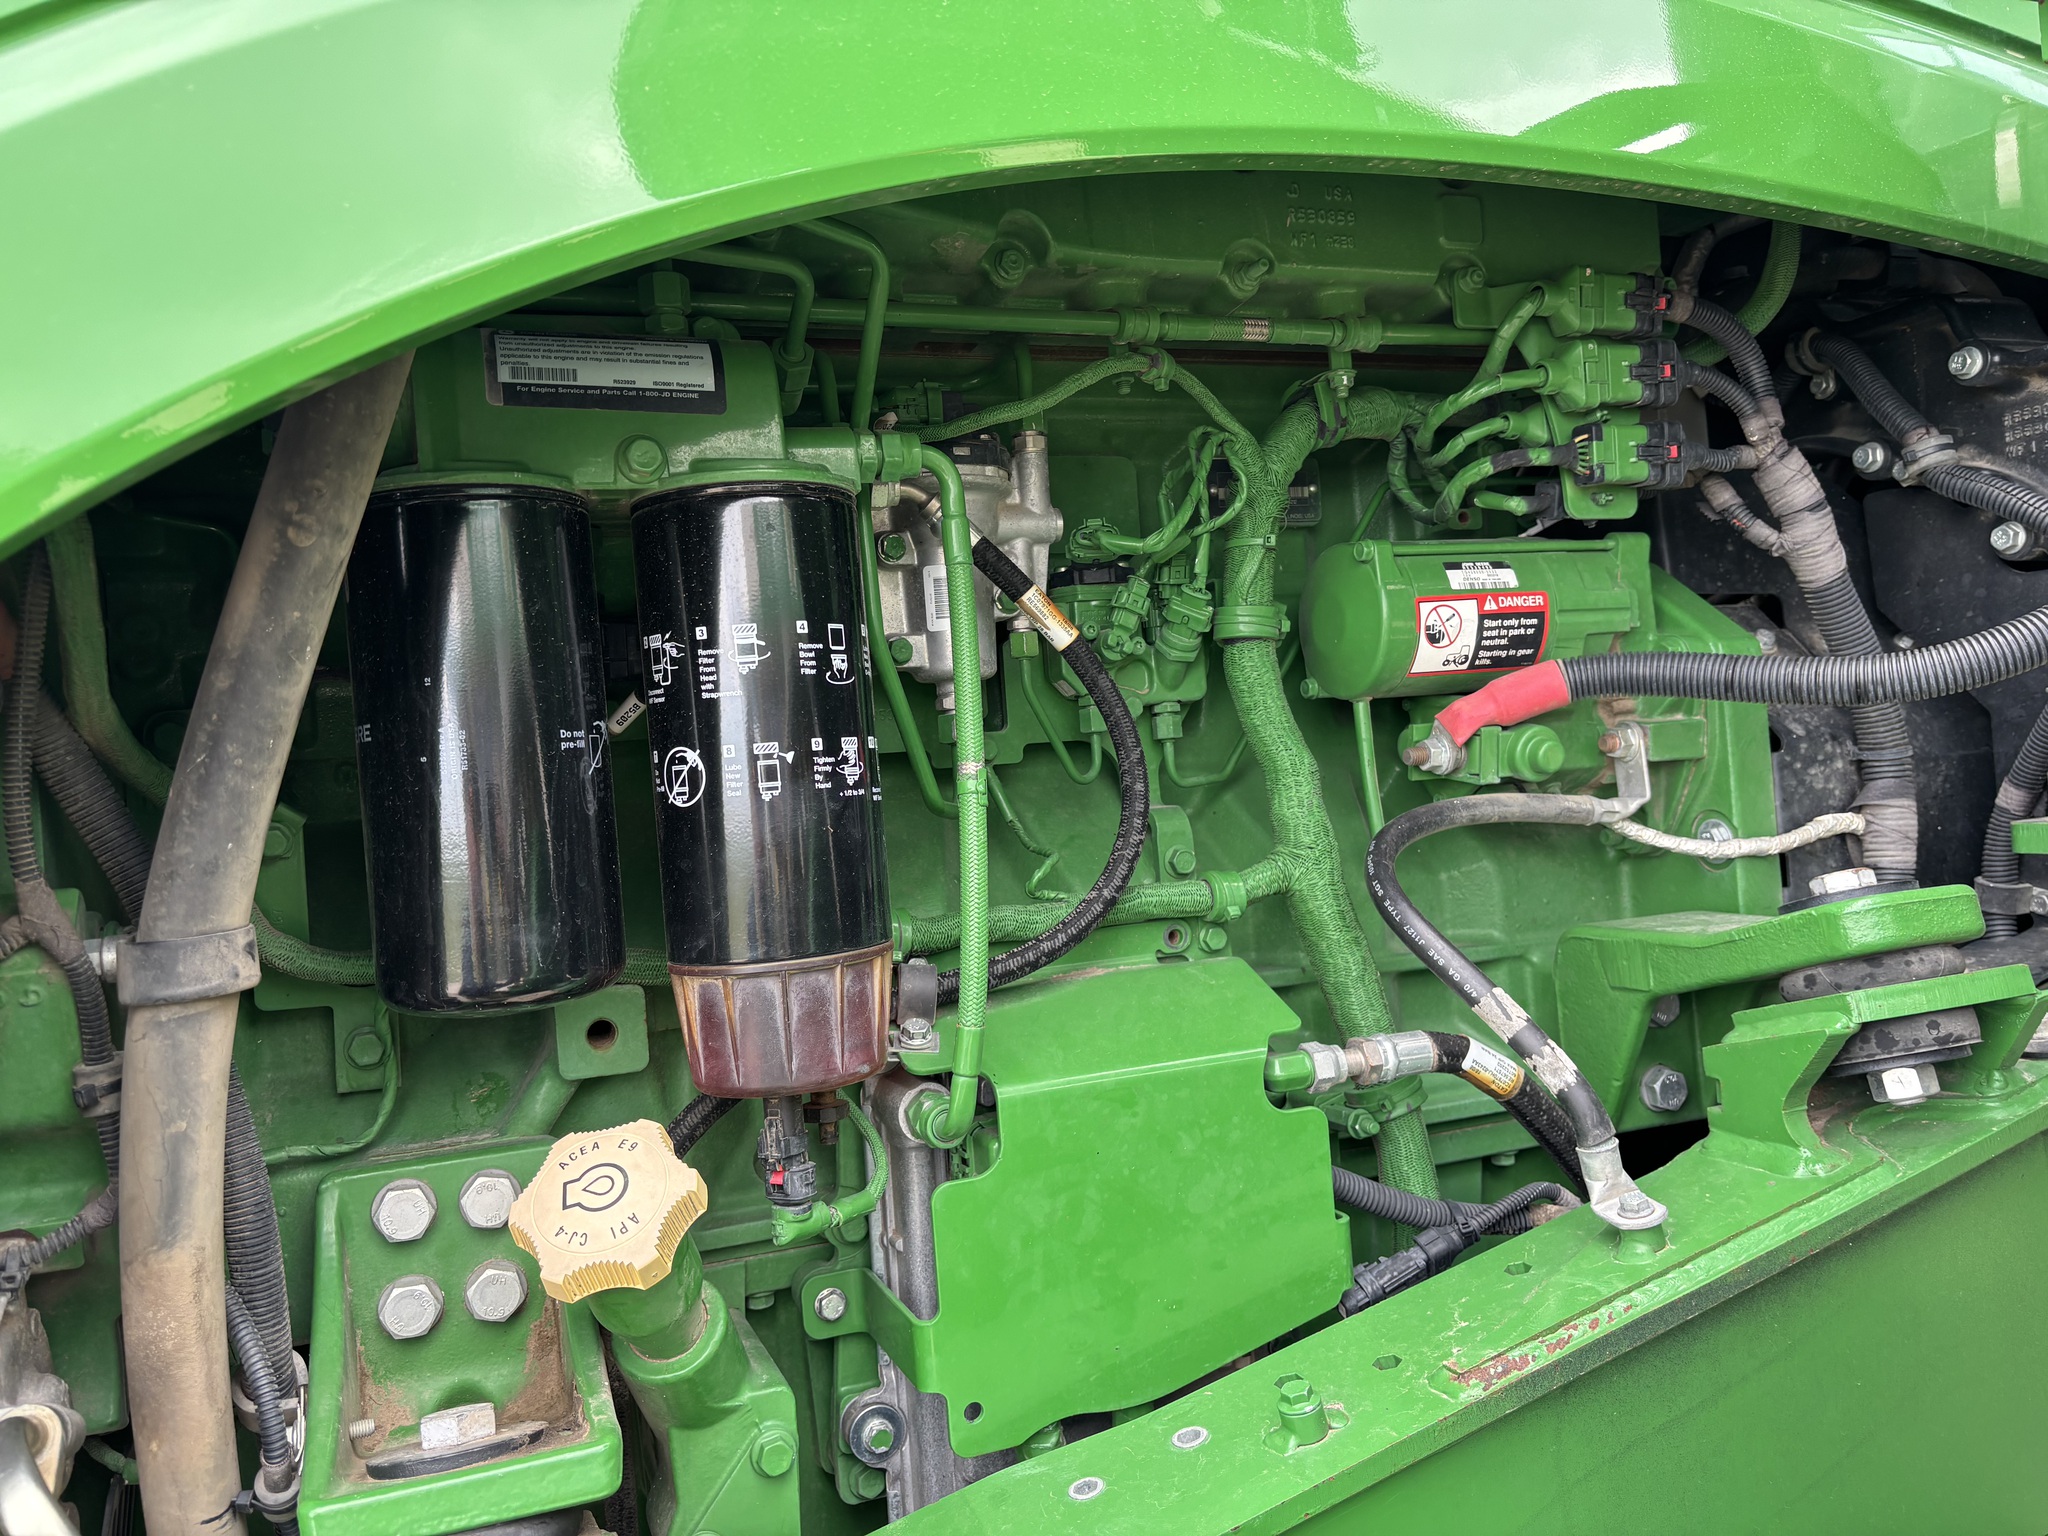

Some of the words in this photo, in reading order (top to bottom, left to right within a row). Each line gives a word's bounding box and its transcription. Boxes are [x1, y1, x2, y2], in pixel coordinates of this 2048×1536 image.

[1325, 185, 1353, 202] USA
[530, 386, 556, 394] Engine
[558, 386, 584, 394] Service
[639, 390, 671, 398] 1-800-JD
[1034, 588, 1052, 606] EATON
[1498, 595, 1544, 608] DANGER
[1483, 619, 1502, 628] Start
[1502, 618, 1520, 628] only
[1520, 617, 1538, 626] from
[1482, 630, 1499, 638] seat
[1500, 628, 1508, 636] in
[1508, 628, 1526, 638] park
[1526, 628, 1536, 636] or
[798, 642, 824, 650] Remove
[1481, 637, 1509, 646] neutral.
[698, 648, 724, 656] Remove
[1478, 650, 1508, 658] Starting
[1516, 648, 1534, 658] gear
[1474, 658, 1492, 666] kills.
[700, 666, 716, 674] From
[424, 677, 432, 686] 12
[700, 674, 717, 682] Head
[702, 690, 742, 699] Strapwrench
[560, 729, 572, 738] Do
[573, 729, 585, 738] not
[560, 739, 586, 751] pre-fill
[812, 756, 836, 764] Tighten
[724, 764, 742, 772] Lube
[814, 765, 832, 773] Firmly
[726, 772, 741, 780] New
[814, 774, 824, 782] By
[815, 782, 832, 790] Hand
[1372, 880, 1384, 897] SGT
[1383, 898, 1402, 923] TYPE
[1402, 924, 1426, 946] J1127
[1427, 948, 1446, 966] SAE
[1448, 966, 1461, 982] GA
[1463, 983, 1478, 998] 4/0
[1491, 1079, 1509, 1093] EATON
[558, 1141, 600, 1171] ACEA
[617, 1138, 639, 1152] E9
[381, 1213, 398, 1236] 10.9
[610, 1212, 640, 1240] API
[554, 1225, 588, 1247] CJ-4
